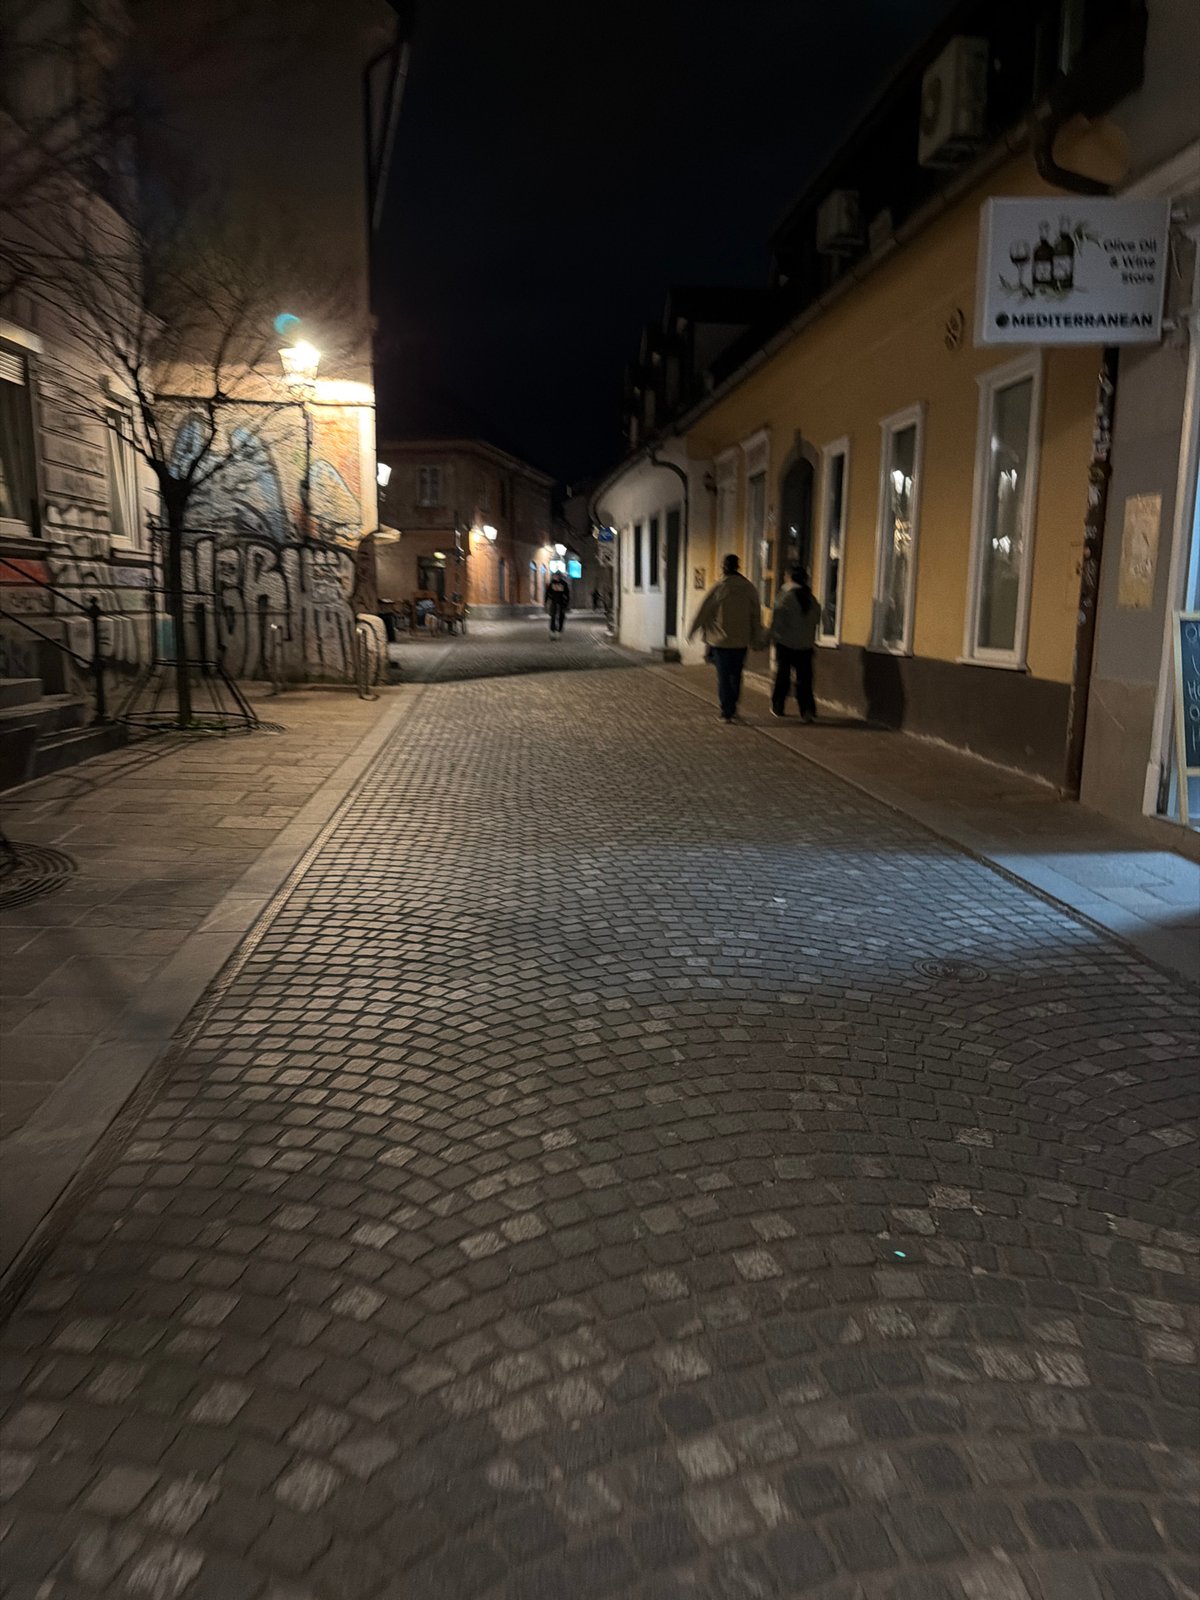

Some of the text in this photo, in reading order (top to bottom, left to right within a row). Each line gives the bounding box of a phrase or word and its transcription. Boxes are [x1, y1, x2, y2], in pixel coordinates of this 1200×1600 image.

[1104, 239, 1136, 254] Olive
[1122, 254, 1156, 270] Wine
[1012, 312, 1153, 329] MEDITERRANEAN
